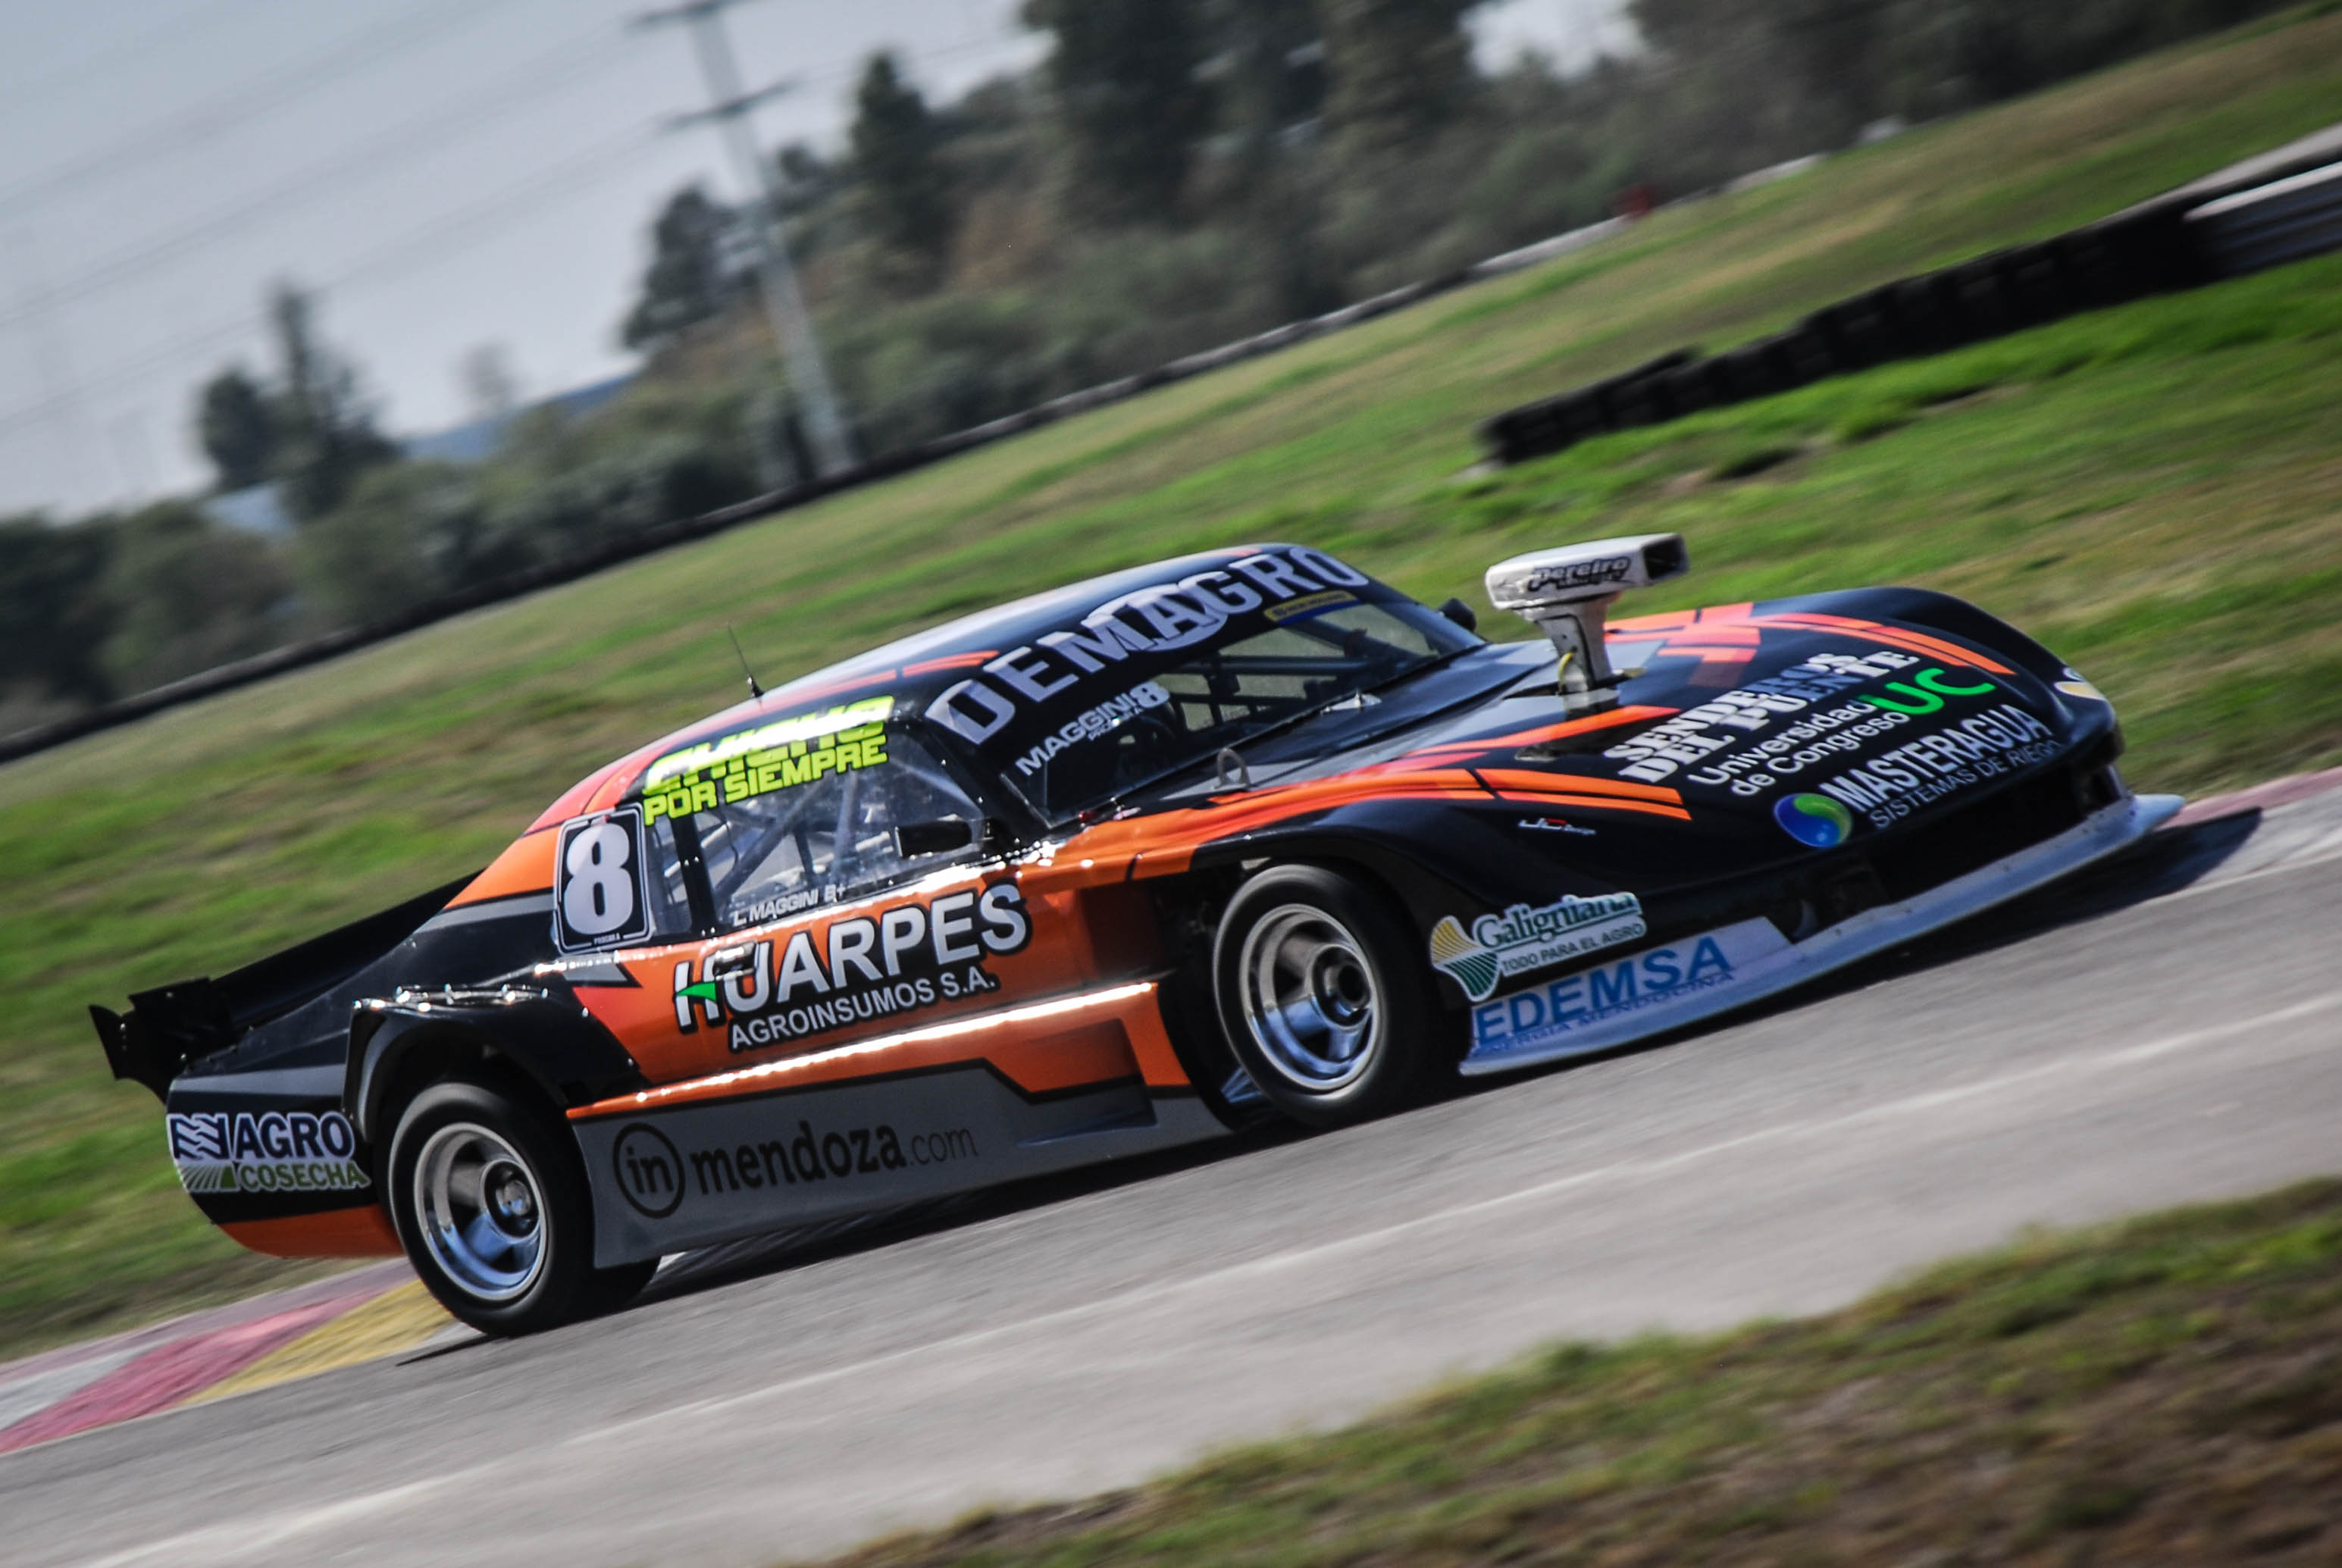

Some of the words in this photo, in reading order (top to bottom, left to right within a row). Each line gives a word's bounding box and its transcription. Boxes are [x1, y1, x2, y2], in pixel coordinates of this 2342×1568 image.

[925, 546, 1369, 744] DEMAGRO
[1015, 693, 1138, 776] MAGGINI
[1129, 681, 1170, 709] 8
[1856, 668, 1996, 715] UC
[643, 781, 719, 826] POR
[724, 734, 888, 803] SIEMPRE
[1618, 732, 1736, 783] DEL
[1688, 699, 1878, 785] Universidad
[1731, 771, 1777, 797] de
[1767, 711, 1911, 775] Congreso
[1818, 703, 2053, 813] MASTERAGUA
[1869, 768, 1979, 829] SISTEMAS
[1974, 758, 2009, 778] DE
[563, 822, 634, 935] 8
[750, 888, 819, 922] MAGGINI
[675, 884, 1028, 1027] HUARPES
[1501, 952, 1539, 972] TODO
[1541, 941, 1579, 962] PARA
[1580, 937, 1598, 950] EL
[1602, 922, 1645, 944] AGRO
[731, 978, 932, 1050] AGROINSUMOS
[944, 967, 996, 998] S.A.
[1475, 937, 1731, 1046] EDEMSA
[235, 1113, 353, 1159] AGRO
[241, 1162, 366, 1189] COSECHA
[690, 1120, 978, 1195] mendoza.com
